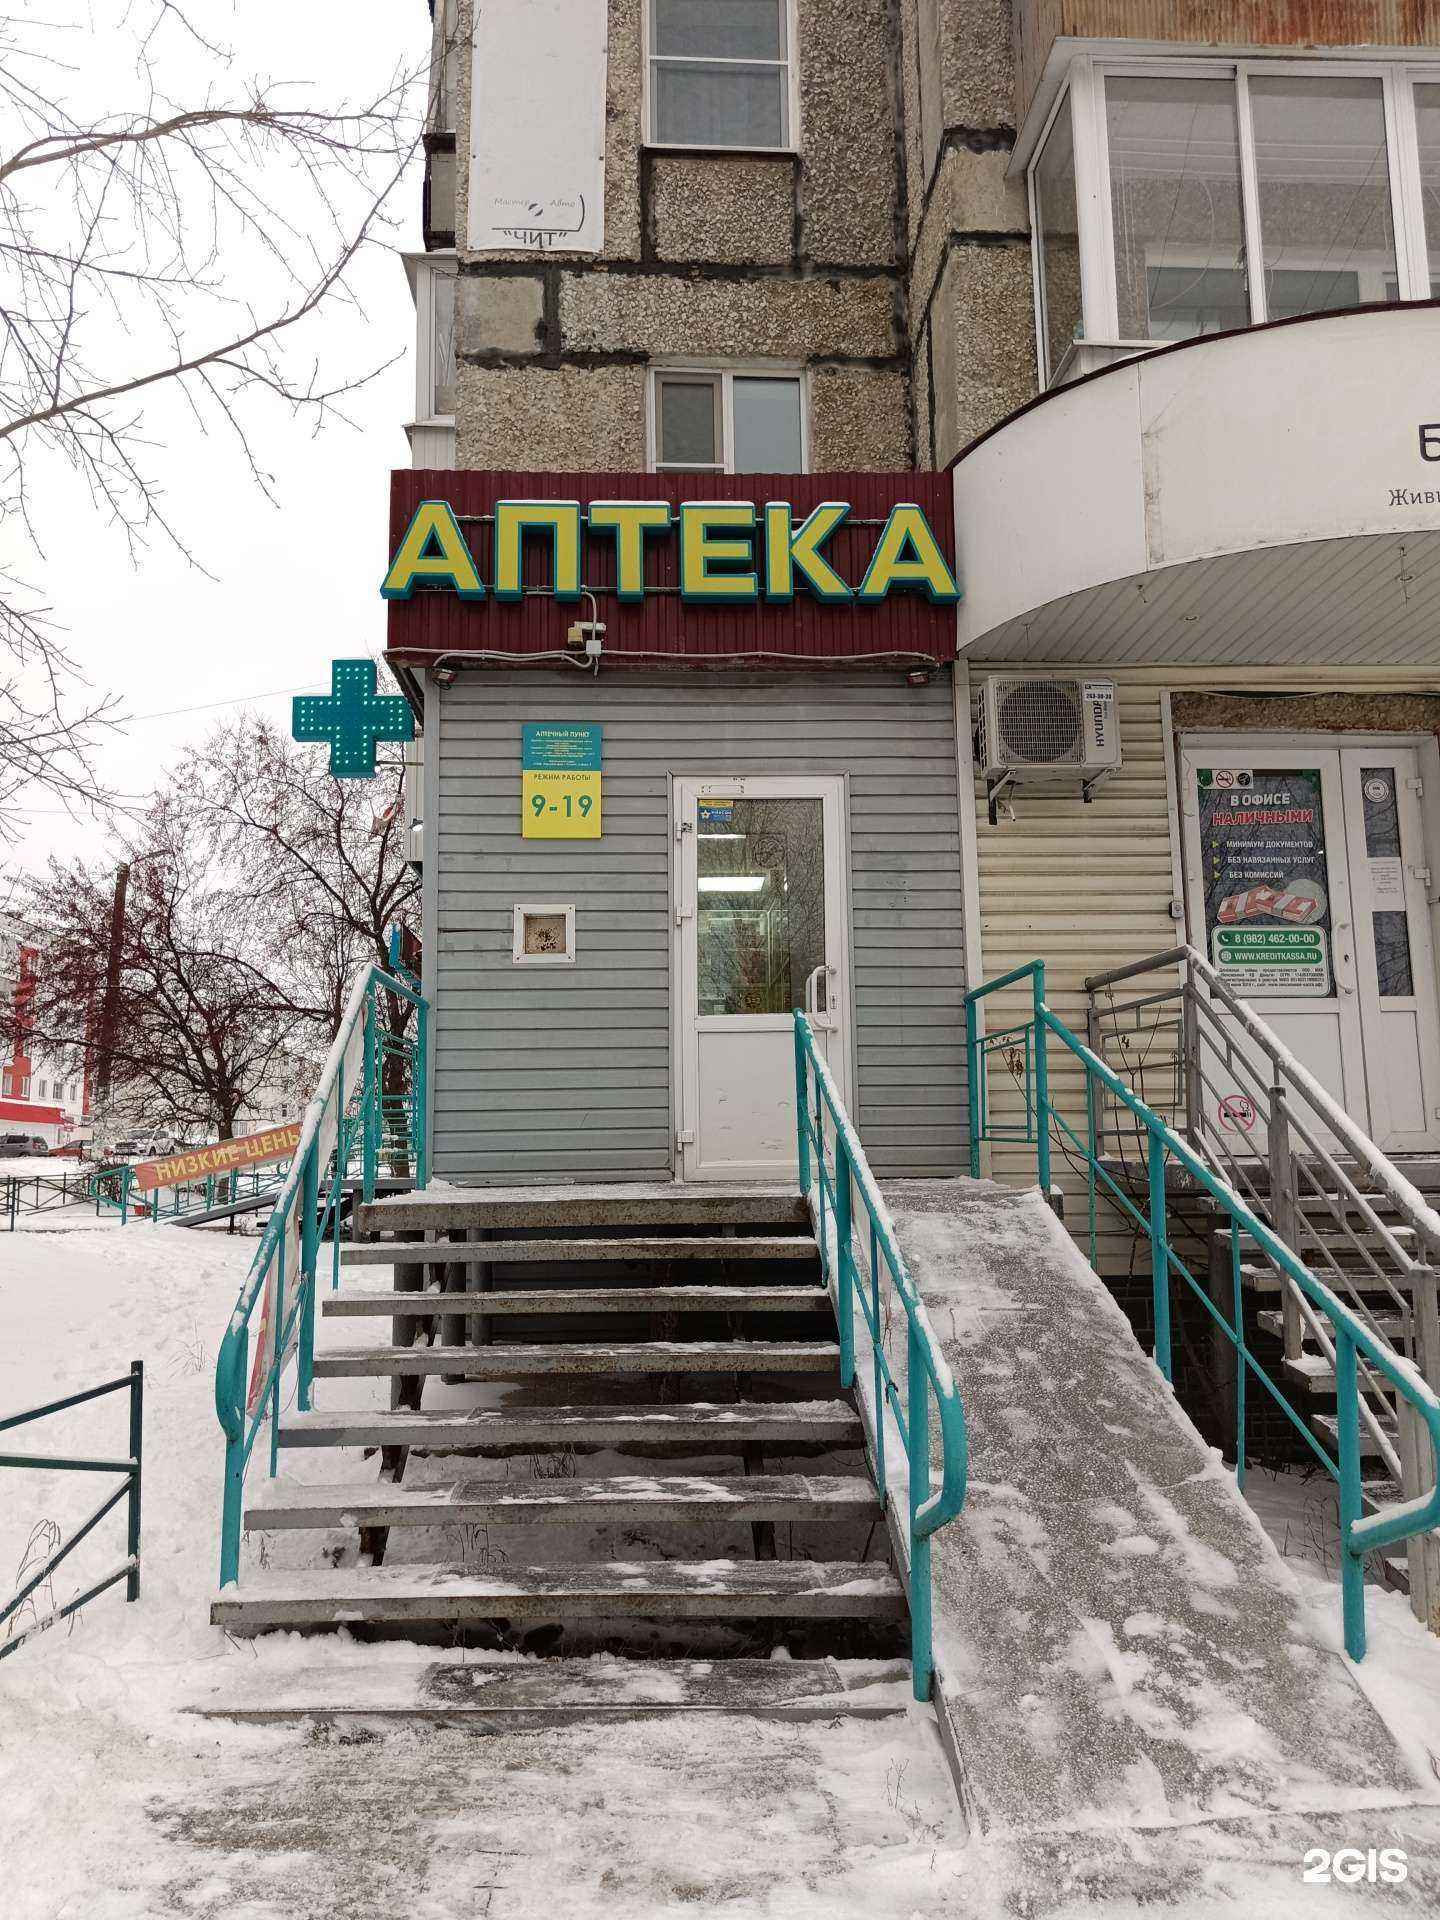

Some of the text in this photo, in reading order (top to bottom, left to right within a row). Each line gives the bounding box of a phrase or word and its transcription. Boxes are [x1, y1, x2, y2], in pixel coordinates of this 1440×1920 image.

[380, 500, 961, 605] АПТЕКА
[1092, 701, 1105, 747] HYUNDA
[535, 730, 590, 739] АПТЕЧНЫЙ ПУНКТ
[1230, 793, 1291, 807] В ОФИСЕ
[531, 794, 593, 818] 9-19
[1212, 809, 1313, 826] НАЛИЧНЫМИ
[1265, 841, 1313, 849] ДОКУМЕНТОВ
[1228, 856, 1315, 864] БЕЗ НАВЯЗАННЫХ УСЛУГ
[1229, 871, 1243, 879] БЕЗ
[1234, 934, 1241, 943] 8
[1234, 952, 1317, 961] WWW.KREDITKASSA.RU
[154, 1144, 240, 1181] НИЗКИЕ
